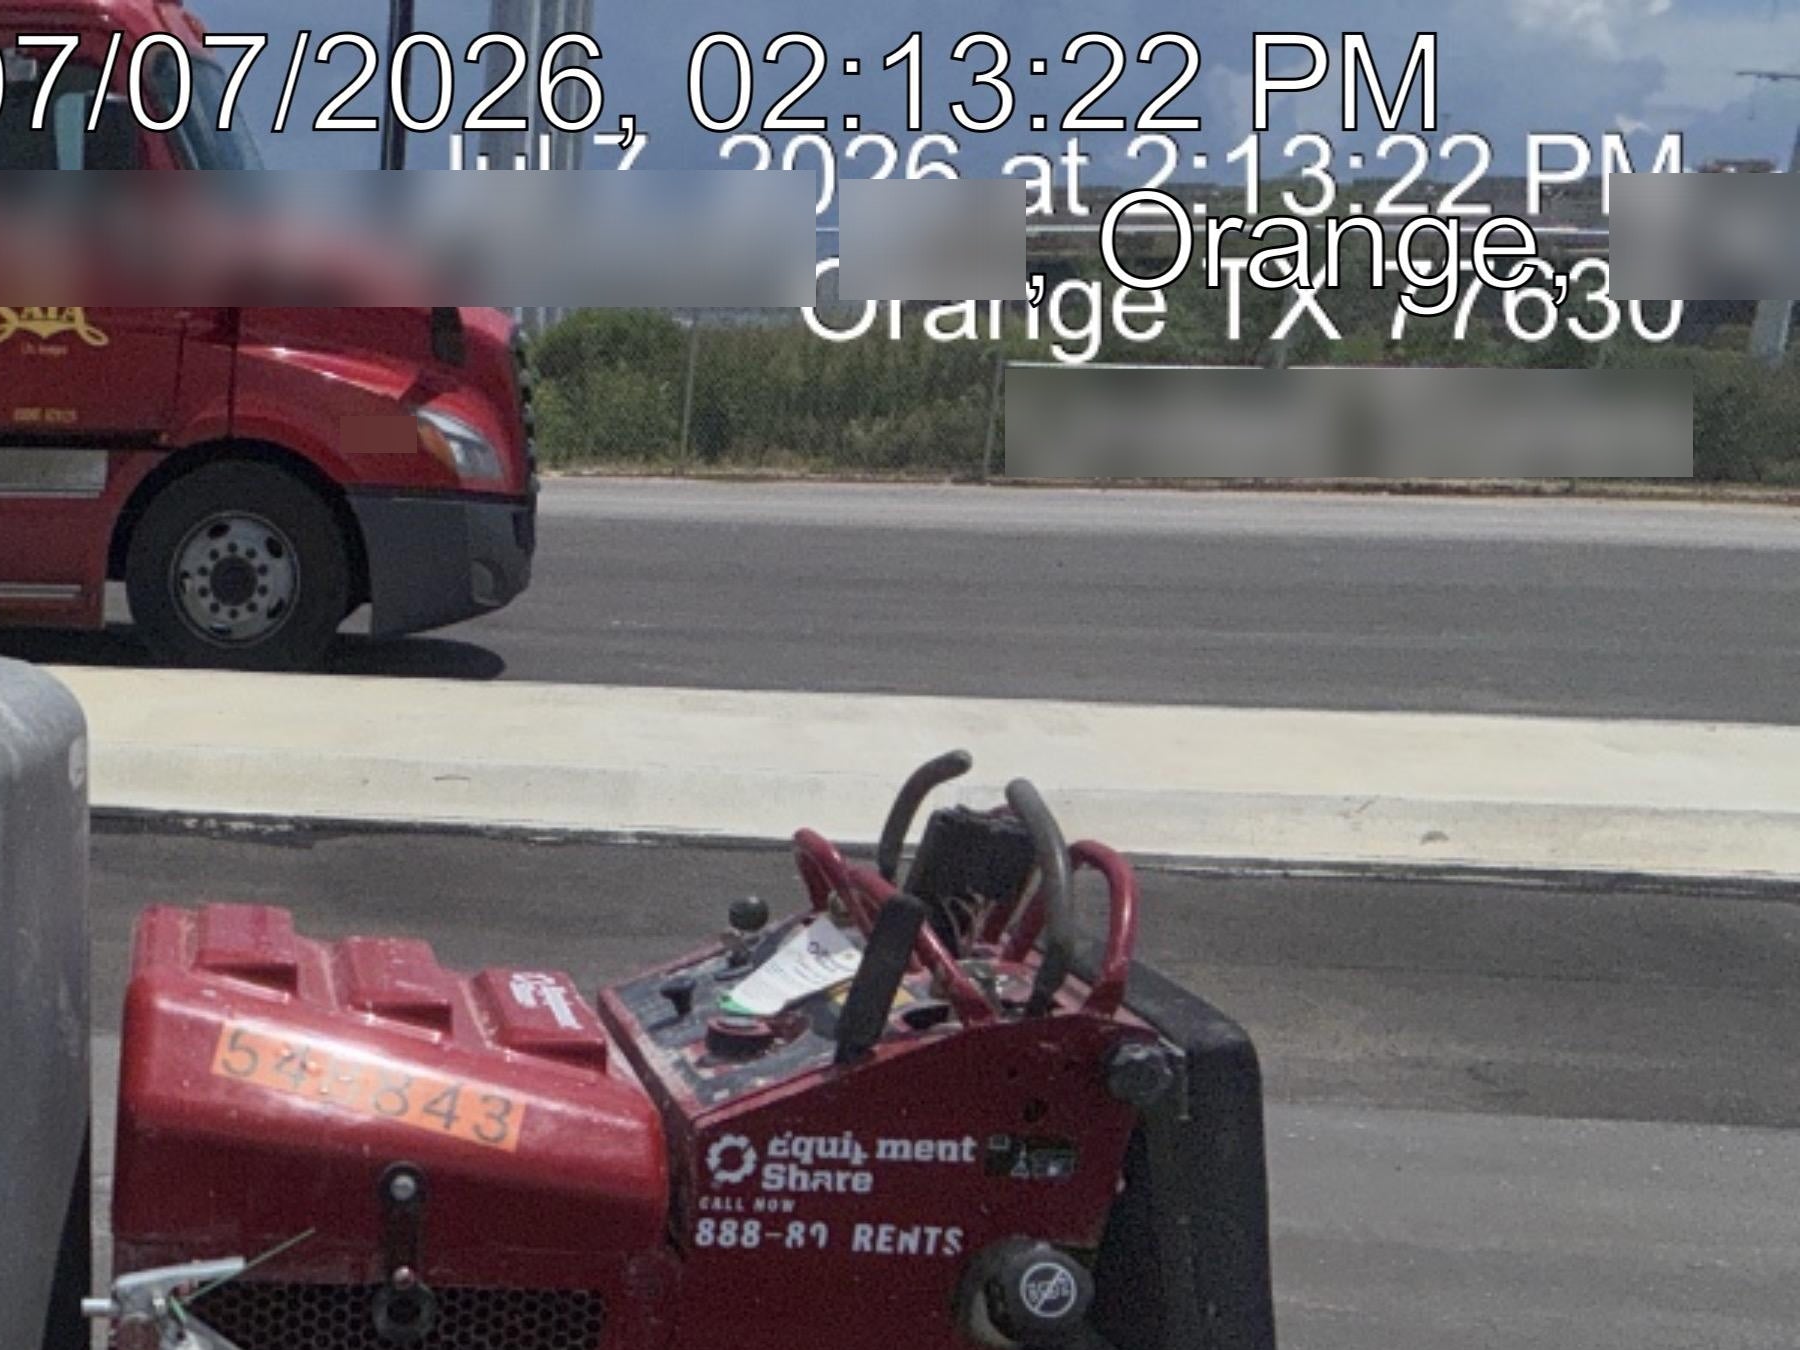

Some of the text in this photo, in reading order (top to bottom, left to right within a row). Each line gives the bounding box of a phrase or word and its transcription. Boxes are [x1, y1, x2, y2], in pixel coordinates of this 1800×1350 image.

[218, 1027, 514, 1144] 54843
[761, 1163, 874, 1193] Share
[698, 1195, 797, 1214] CALL NOW
[851, 1222, 965, 1256] RENTS
